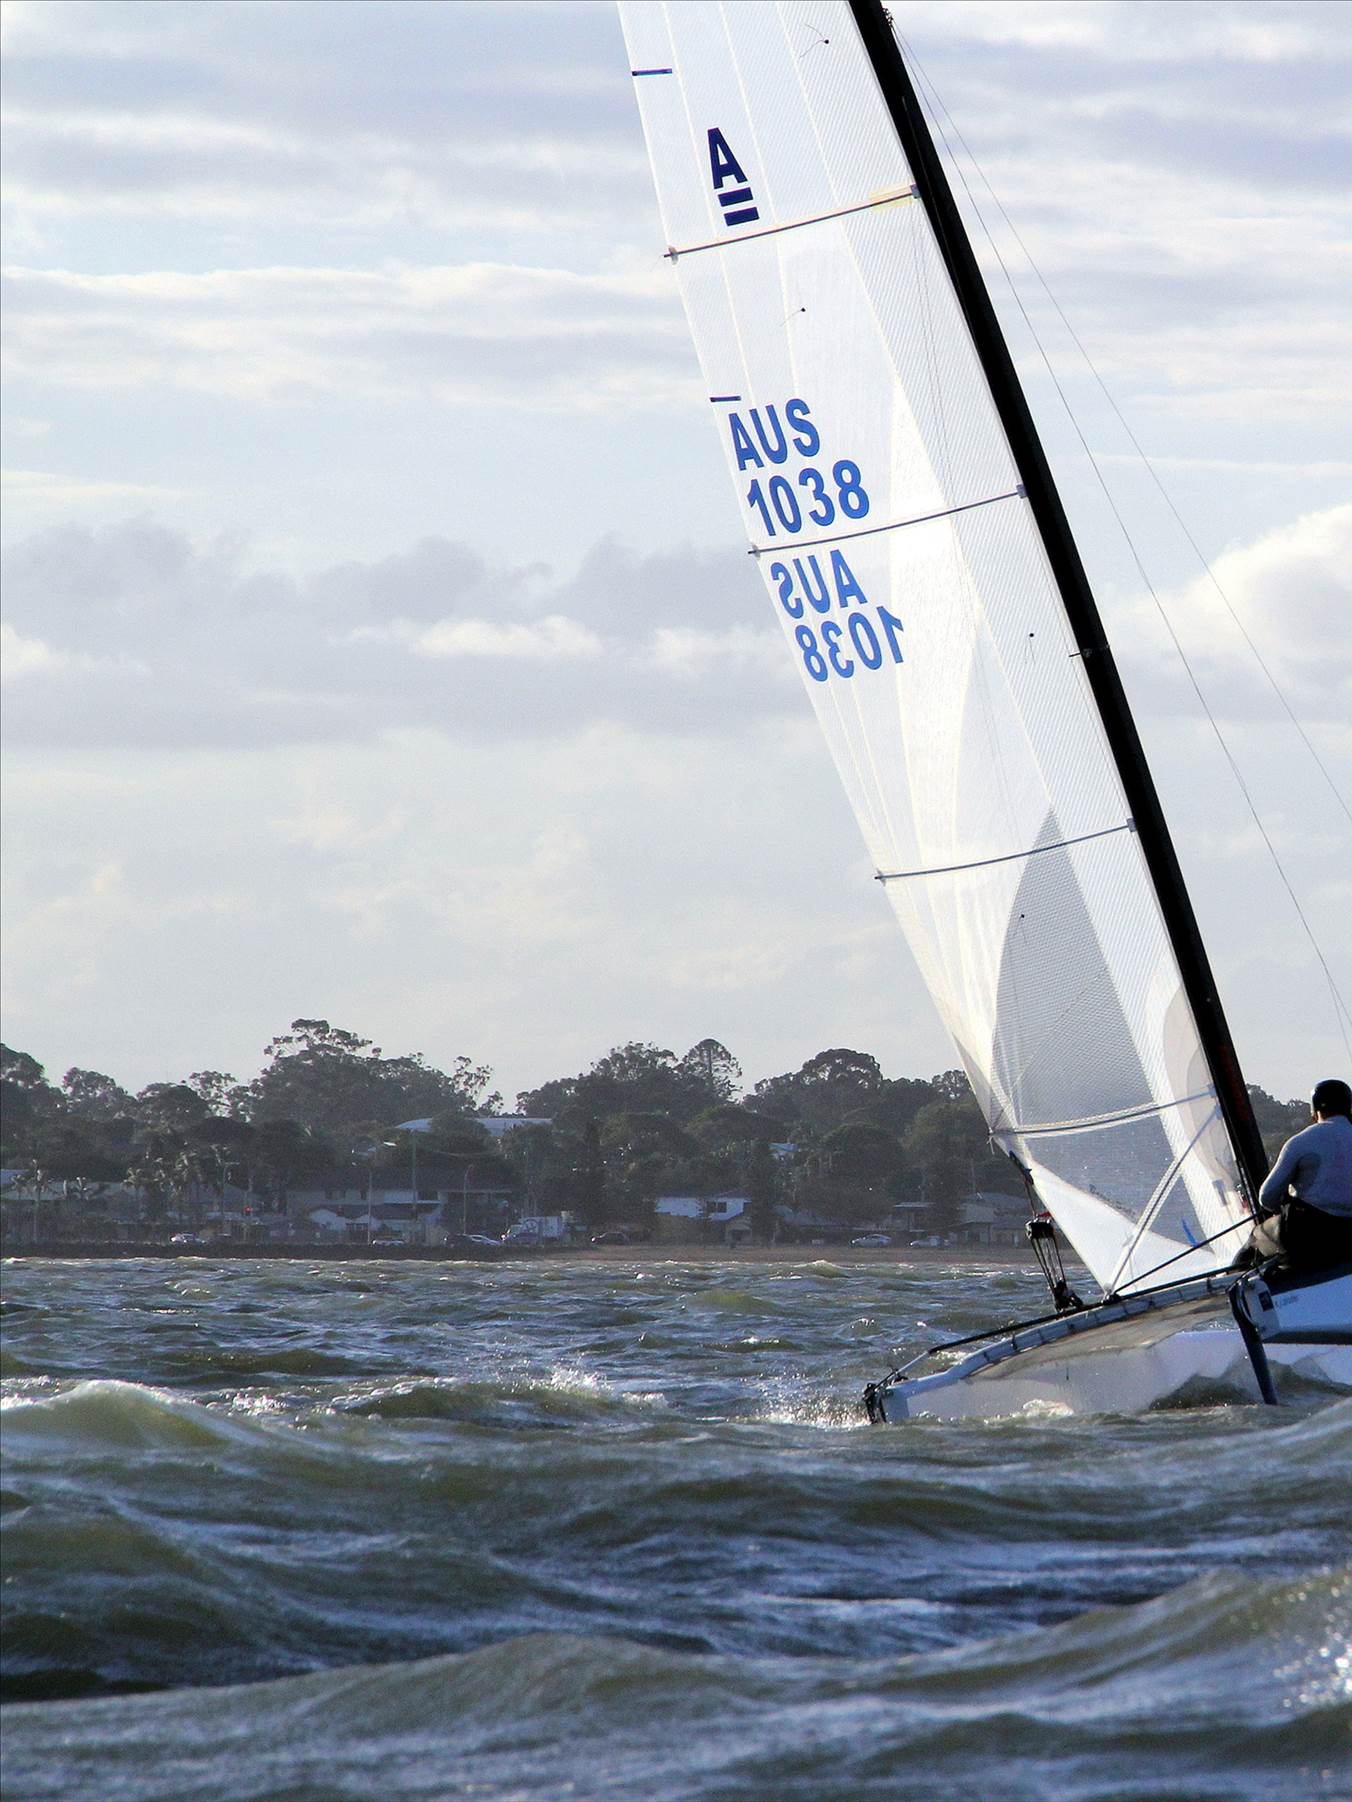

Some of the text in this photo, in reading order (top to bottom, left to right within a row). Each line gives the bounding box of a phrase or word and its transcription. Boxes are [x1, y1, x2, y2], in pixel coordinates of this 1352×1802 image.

[707, 127, 748, 189] A
[729, 399, 820, 471] AUS
[747, 460, 870, 536] 1038
